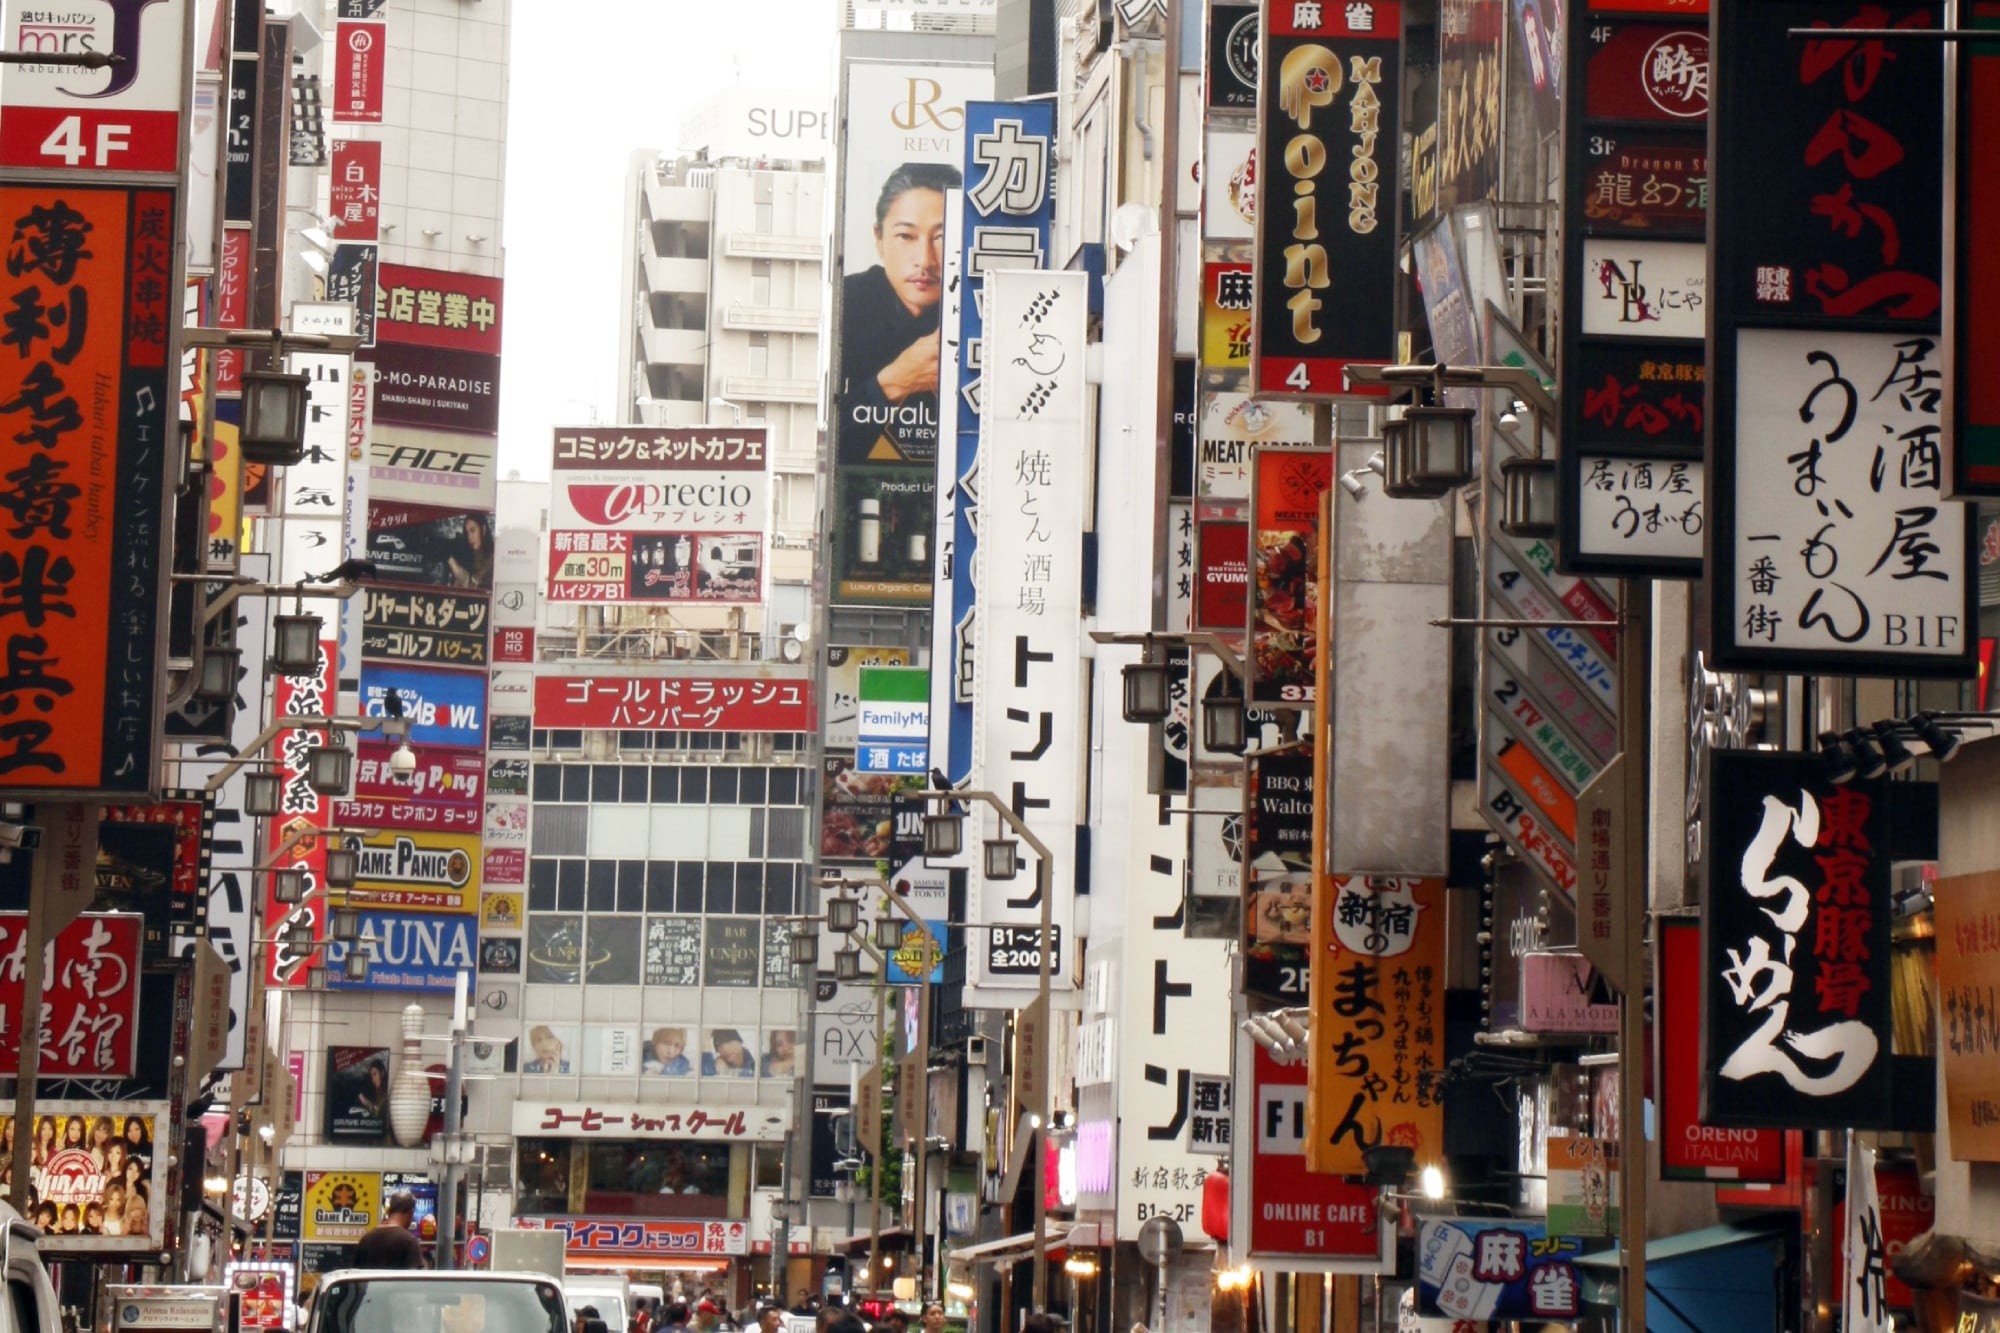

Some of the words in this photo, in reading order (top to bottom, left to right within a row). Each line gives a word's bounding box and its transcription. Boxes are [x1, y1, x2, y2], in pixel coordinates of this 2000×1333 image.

[1291, 2, 1374, 31] 麻雀
[1590, 26, 1612, 43] 4F
[40, 115, 131, 167] 4F
[1348, 55, 1382, 234] MAHJONG
[1589, 135, 1616, 156] 3F
[1621, 155, 1683, 171] Dragon
[343, 160, 378, 222] 白木屋
[137, 206, 167, 346] 炭火串焼
[350, 383, 367, 447] カラオケ
[898, 427, 914, 439] BY
[558, 435, 763, 461] コミック&ネットカフェ
[1203, 440, 1245, 464] MEAT
[1865, 337, 1949, 583] 居酒屋
[1206, 466, 1247, 481] ミート
[1584, 460, 1694, 495] 居酒屋
[604, 475, 751, 521] aprecio
[880, 481, 917, 493] Product
[1787, 350, 1871, 644] うまいもん
[555, 532, 627, 551] 新宿最大
[1014, 448, 1053, 618] 焼とん酒場
[210, 540, 233, 560] 神
[392, 552, 424, 563] POINT
[643, 569, 690, 587] ダーツ
[1498, 570, 1521, 590] 4
[1743, 533, 1783, 643] 一番街
[552, 583, 625, 599] ハイジアB1
[1497, 625, 1521, 647] 3
[1883, 613, 1959, 649] B1F
[387, 631, 433, 658] ゴルフ
[436, 639, 484, 661] バグース
[829, 649, 842, 661] 8F
[566, 680, 803, 705] ゴールドラッシュ
[1494, 680, 1519, 705] 2
[1513, 698, 1544, 728] TV
[611, 706, 724, 728] ハンバーグ
[868, 748, 890, 769] 酒
[356, 758, 378, 784] 京
[1006, 634, 1054, 909] トントン
[1266, 775, 1300, 791] BBQ
[338, 802, 385, 819] カラオケ
[391, 805, 437, 822] ビアポン
[444, 808, 478, 824] ダーツ
[1262, 796, 1313, 815] Walto
[1490, 789, 1524, 824] B1
[396, 837, 448, 879] PANIC
[1591, 807, 1612, 940] 劇場通り一番街
[913, 890, 946, 898] TOKYO
[1814, 786, 1871, 1018] 東京豚骨
[725, 927, 747, 938] BAR
[772, 926, 791, 944] 女
[891, 950, 943, 962] AMIO
[1280, 967, 1309, 993] 2F
[819, 987, 832, 998] 2F
[611, 1031, 624, 1071] BLUE
[1329, 961, 1389, 1149] まっちゃん
[1685, 1124, 1758, 1143] ORENO
[1684, 1145, 1759, 1162] ITALIAN
[315, 1208, 341, 1223] GAME
[342, 1206, 369, 1223] PANIC
[1263, 1202, 1321, 1222] ONLINE
[1327, 1204, 1367, 1223] CAFE
[707, 1222, 726, 1253] 免税
[1305, 1229, 1325, 1248] B1
